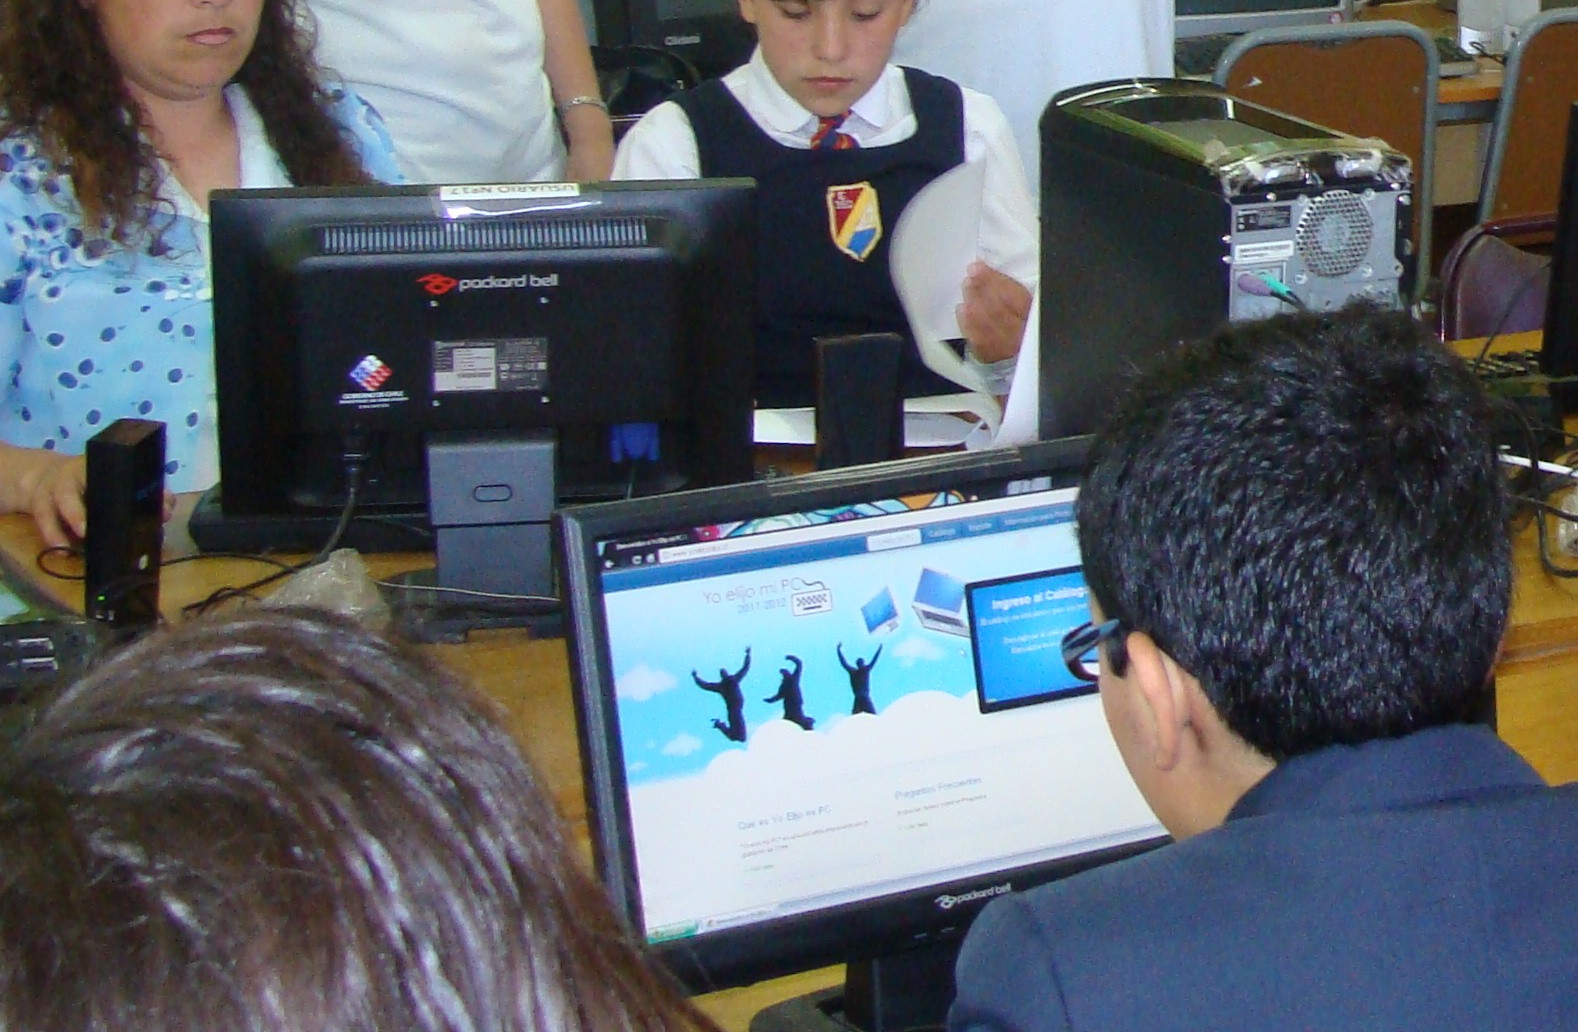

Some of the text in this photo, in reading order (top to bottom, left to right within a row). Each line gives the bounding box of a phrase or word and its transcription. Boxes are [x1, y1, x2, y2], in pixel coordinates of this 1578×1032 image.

[490, 183, 576, 196] USUARIO
[459, 273, 559, 292] packard bell
[702, 590, 722, 604] Yo
[781, 576, 803, 591] PC
[957, 882, 1012, 904] packard bell
